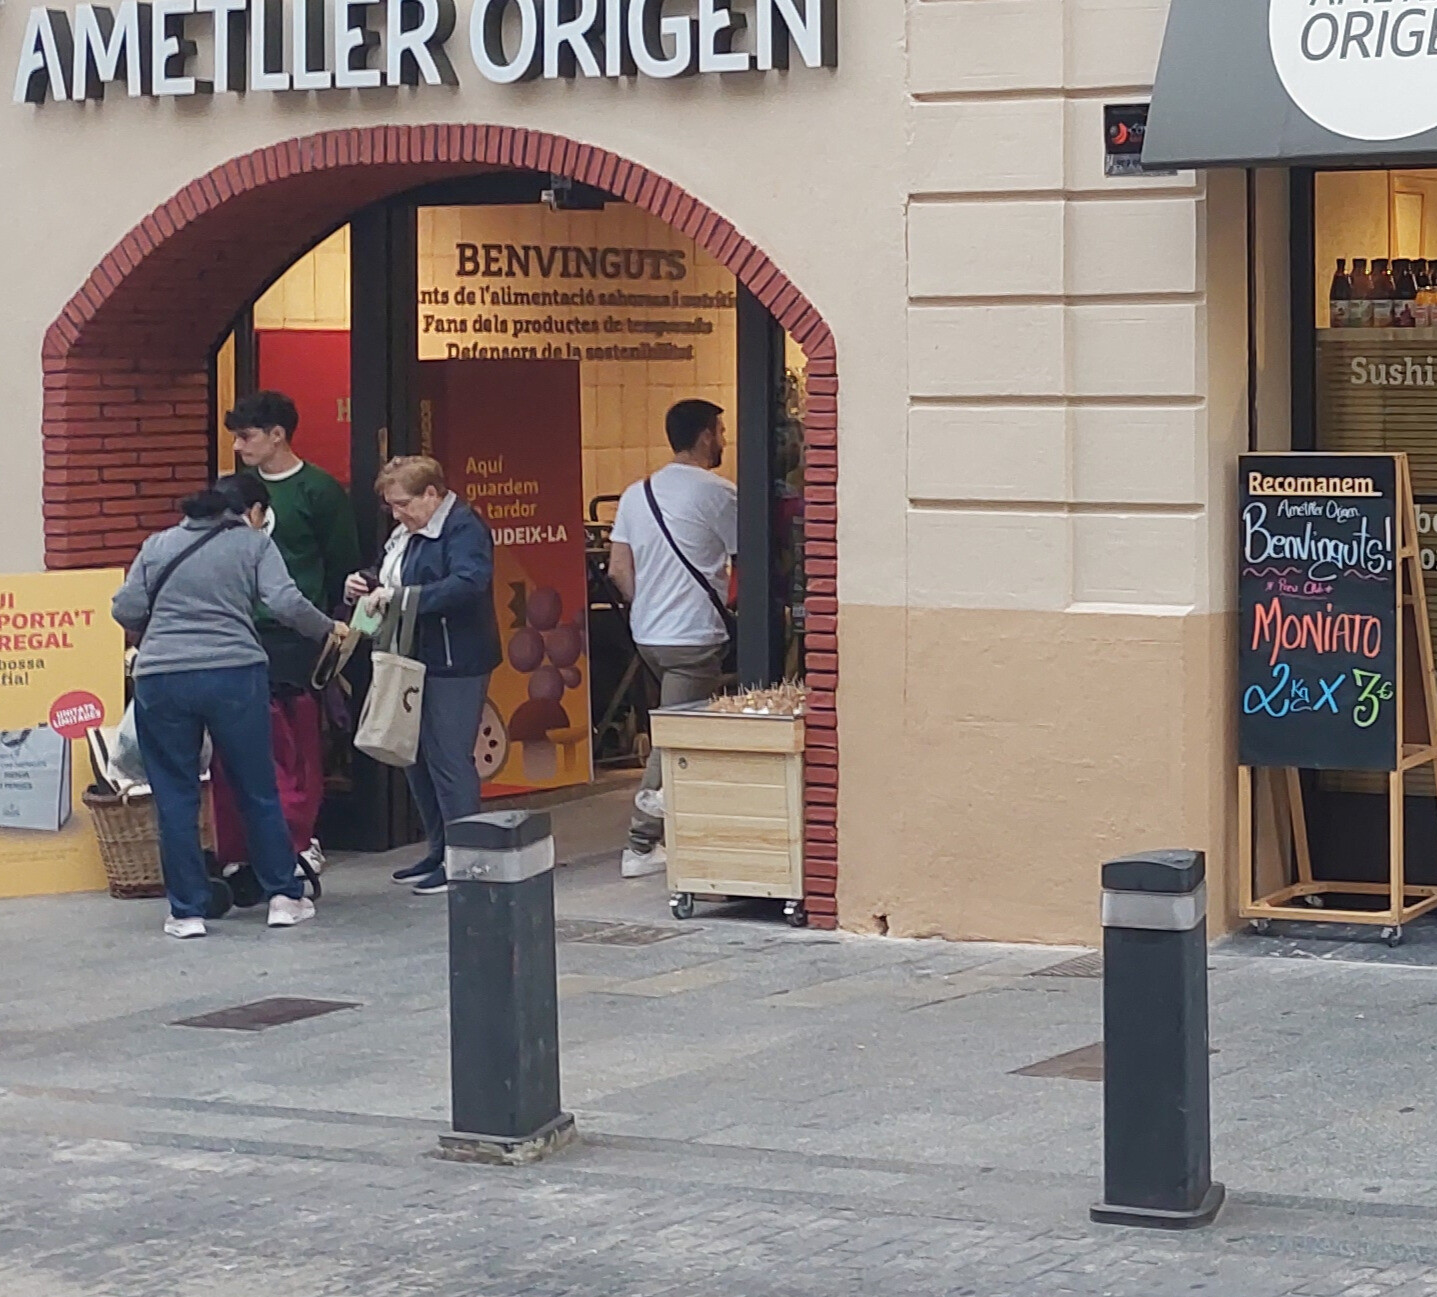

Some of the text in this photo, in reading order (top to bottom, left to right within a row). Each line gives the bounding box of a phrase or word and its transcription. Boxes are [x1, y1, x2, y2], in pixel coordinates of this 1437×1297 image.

[456, 243, 687, 281] BENVINGUTS
[454, 286, 476, 305] de
[423, 314, 468, 333] Fans
[512, 315, 600, 338] productes
[1350, 356, 1436, 387] Sushi
[466, 477, 539, 502] guardem
[1248, 472, 1374, 494] Recomanem
[487, 499, 537, 520] tardor
[1242, 502, 1393, 581] Benvinguts!
[0, 632, 74, 652] REGAL
